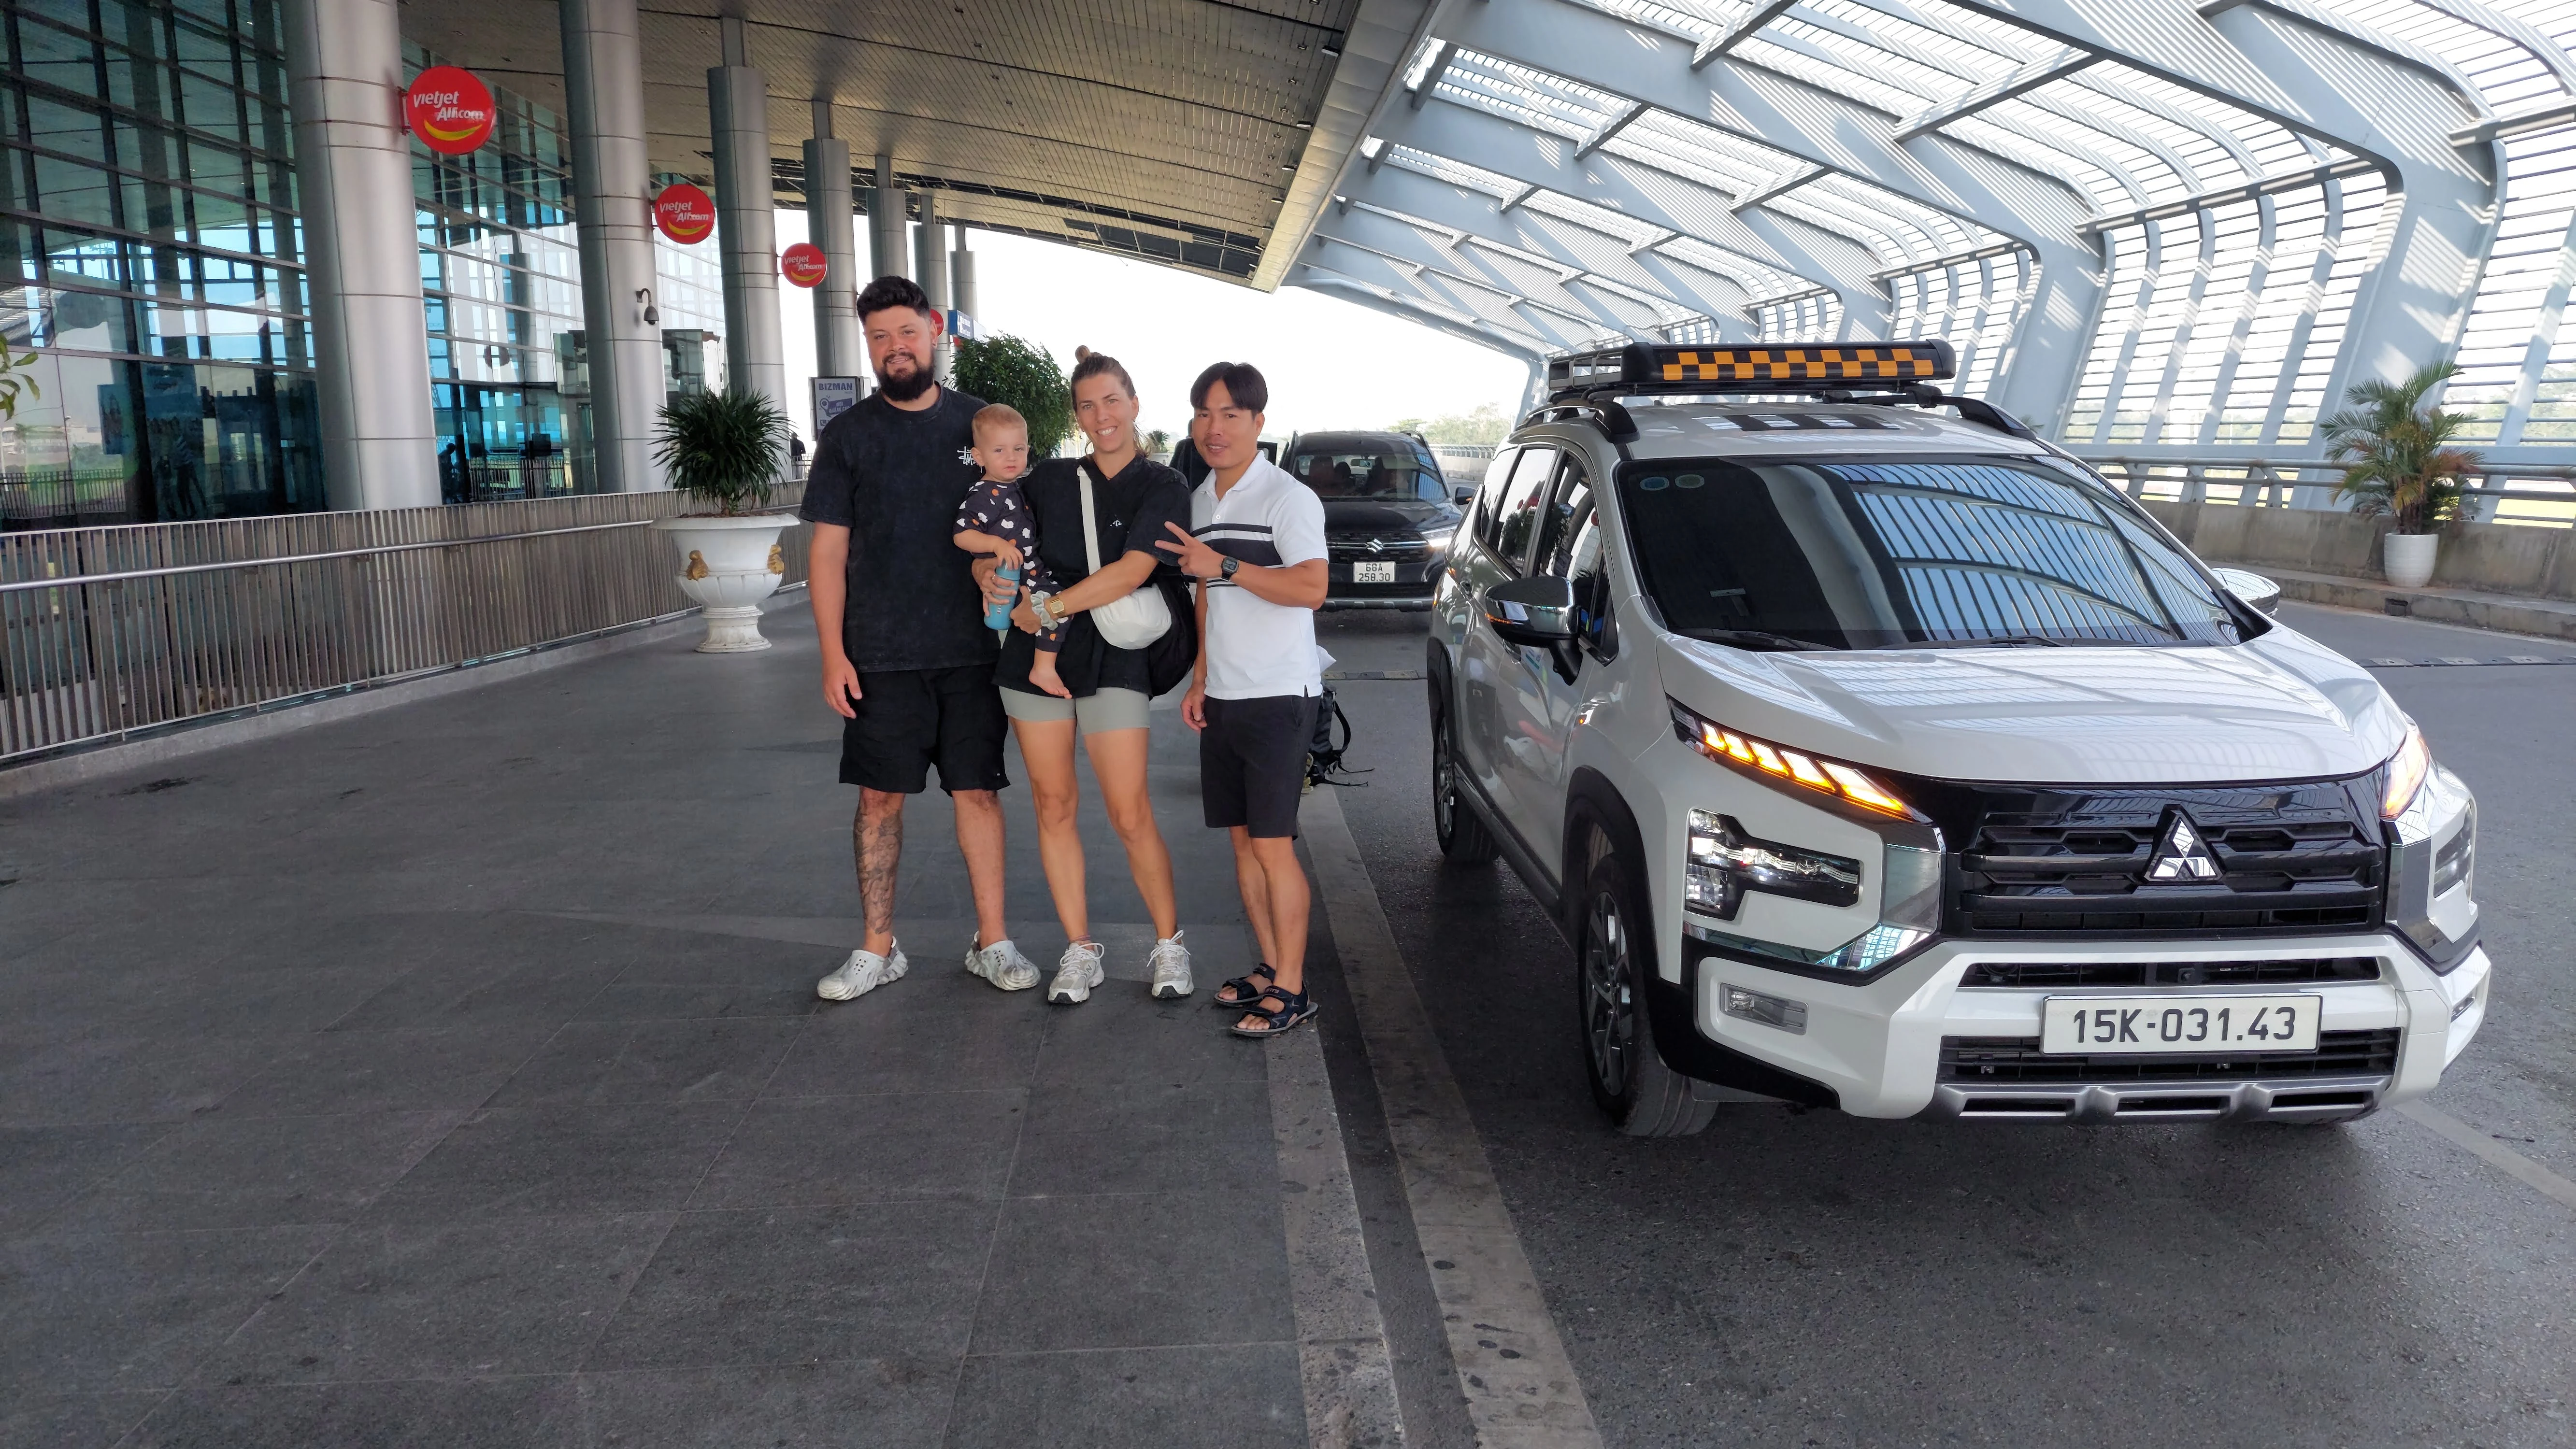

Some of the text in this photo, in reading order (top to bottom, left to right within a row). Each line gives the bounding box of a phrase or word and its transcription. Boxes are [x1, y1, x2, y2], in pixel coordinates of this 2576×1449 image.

[818, 383, 853, 391] BIZMAN
[1365, 563, 1383, 572] 68A
[1359, 573, 1390, 582] 258.30
[2074, 1006, 2297, 1043] 15K-031.43
